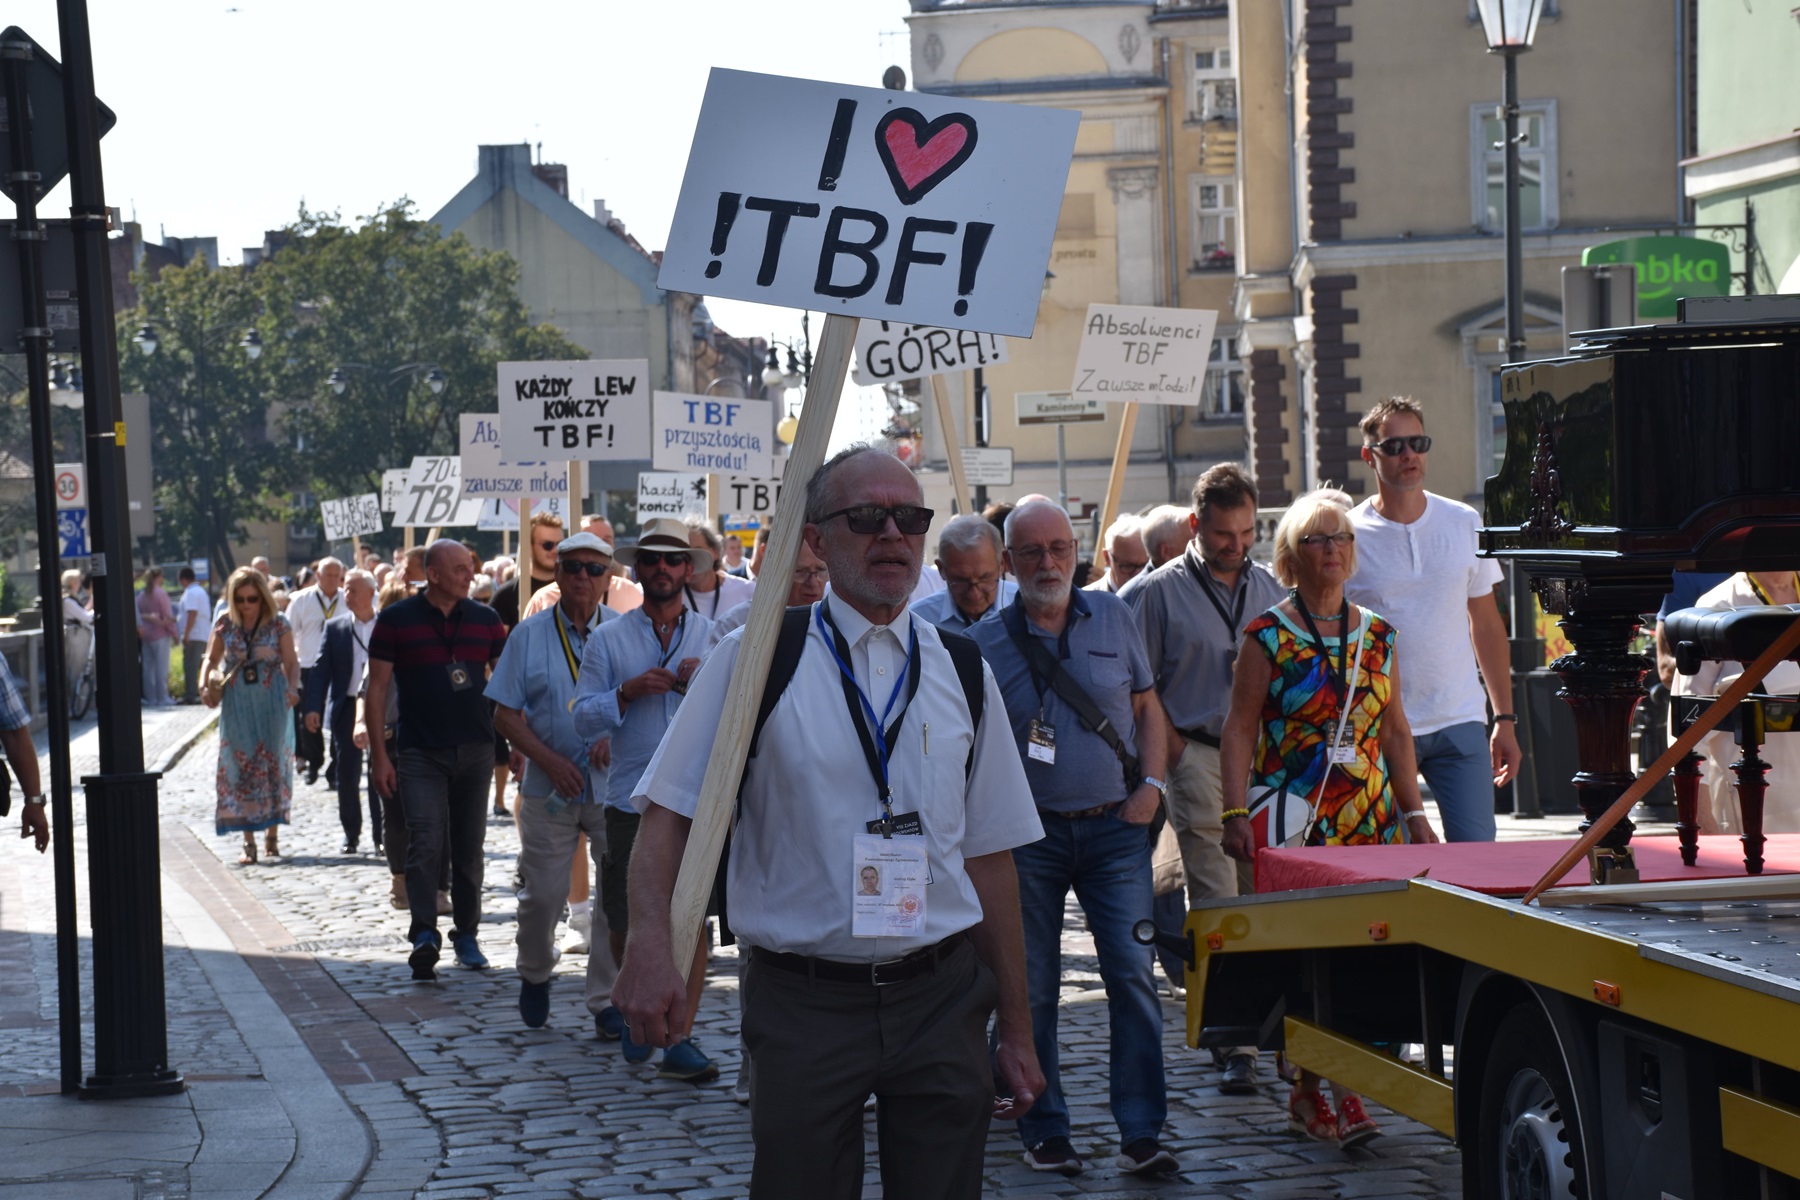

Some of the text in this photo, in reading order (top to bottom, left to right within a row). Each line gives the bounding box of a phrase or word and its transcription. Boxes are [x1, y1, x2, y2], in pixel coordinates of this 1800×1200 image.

[818, 98, 858, 191] I
[705, 192, 995, 316] !TBF!
[1609, 254, 1717, 284] bka
[1088, 313, 1202, 339] Absolwenci
[1123, 341, 1169, 366] TBF
[515, 374, 636, 401] KAŻDY LEW
[544, 396, 609, 420] KOŃCZY
[683, 400, 741, 426] TBF
[1036, 402, 1085, 414] Kamienny
[534, 424, 614, 448] TBF!
[665, 428, 762, 454] przyszłością
[421, 457, 451, 483] 70
[687, 452, 748, 471] narodu!
[60, 480, 76, 494] 30
[465, 471, 568, 493] zawsze młod
